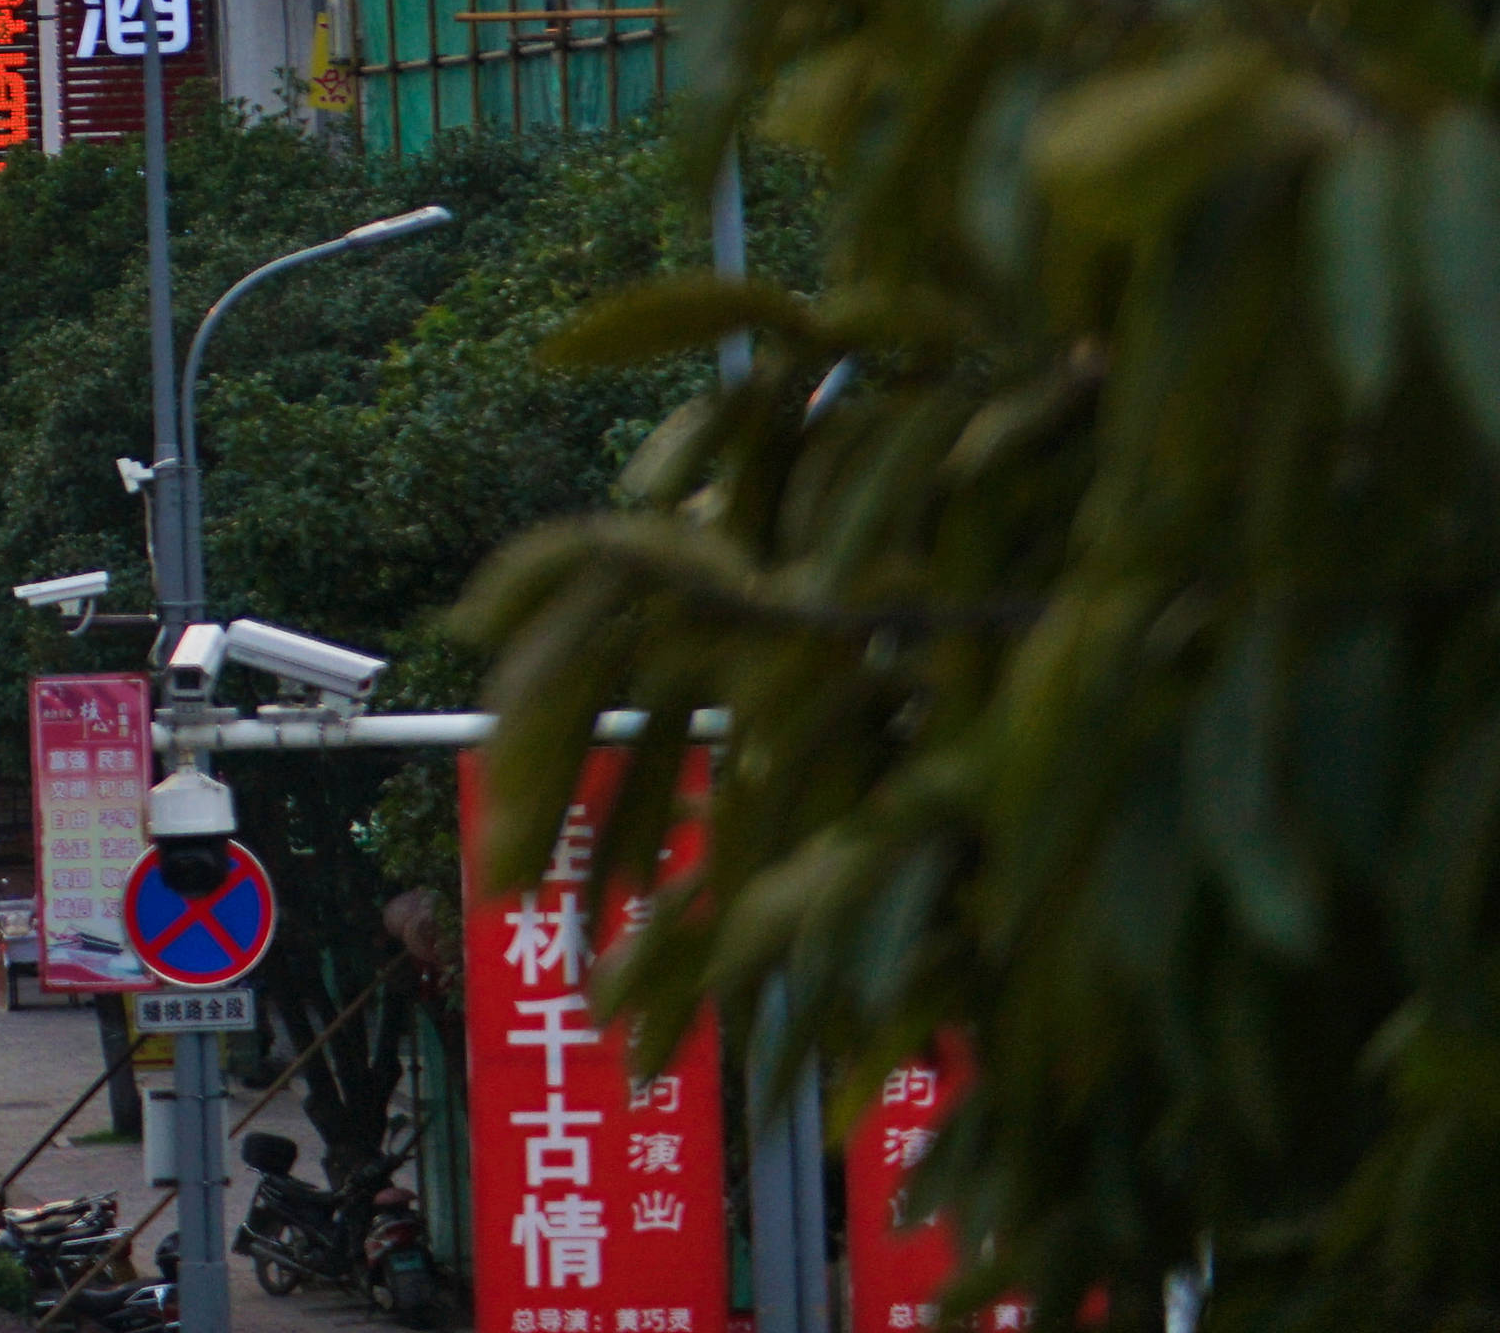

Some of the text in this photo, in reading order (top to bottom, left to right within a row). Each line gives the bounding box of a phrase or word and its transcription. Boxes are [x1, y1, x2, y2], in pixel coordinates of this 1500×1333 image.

[49, 749, 135, 770] 富强 民主
[50, 779, 136, 800] 文明 和谐
[51, 808, 137, 830] 自由 平等
[51, 838, 92, 859] 公正
[614, 1307, 693, 1333] 黄巧灵
